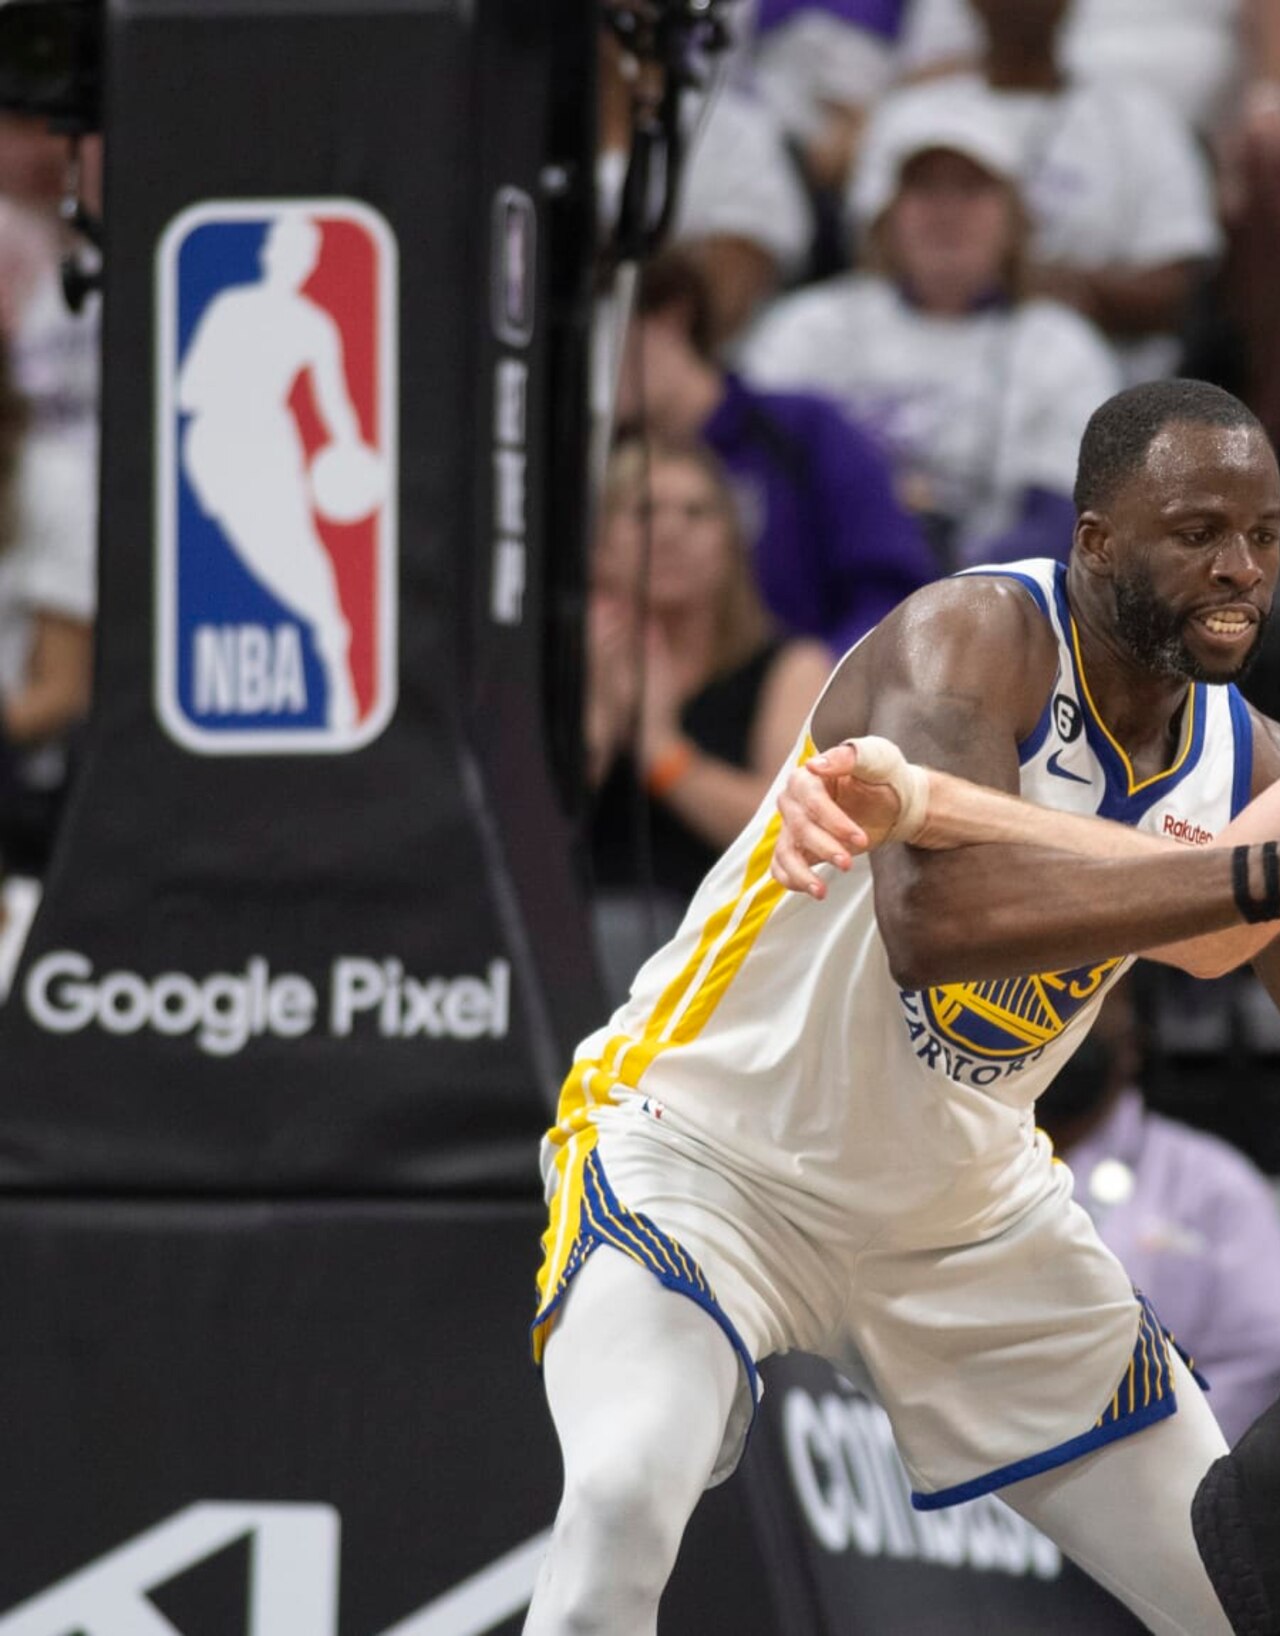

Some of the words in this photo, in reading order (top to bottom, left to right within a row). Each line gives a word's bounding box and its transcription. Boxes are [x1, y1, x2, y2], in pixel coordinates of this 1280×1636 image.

[193, 622, 308, 716] NBA
[1056, 699, 1077, 739] 6
[25, 950, 317, 1055] Google
[331, 954, 512, 1039] Pixel
